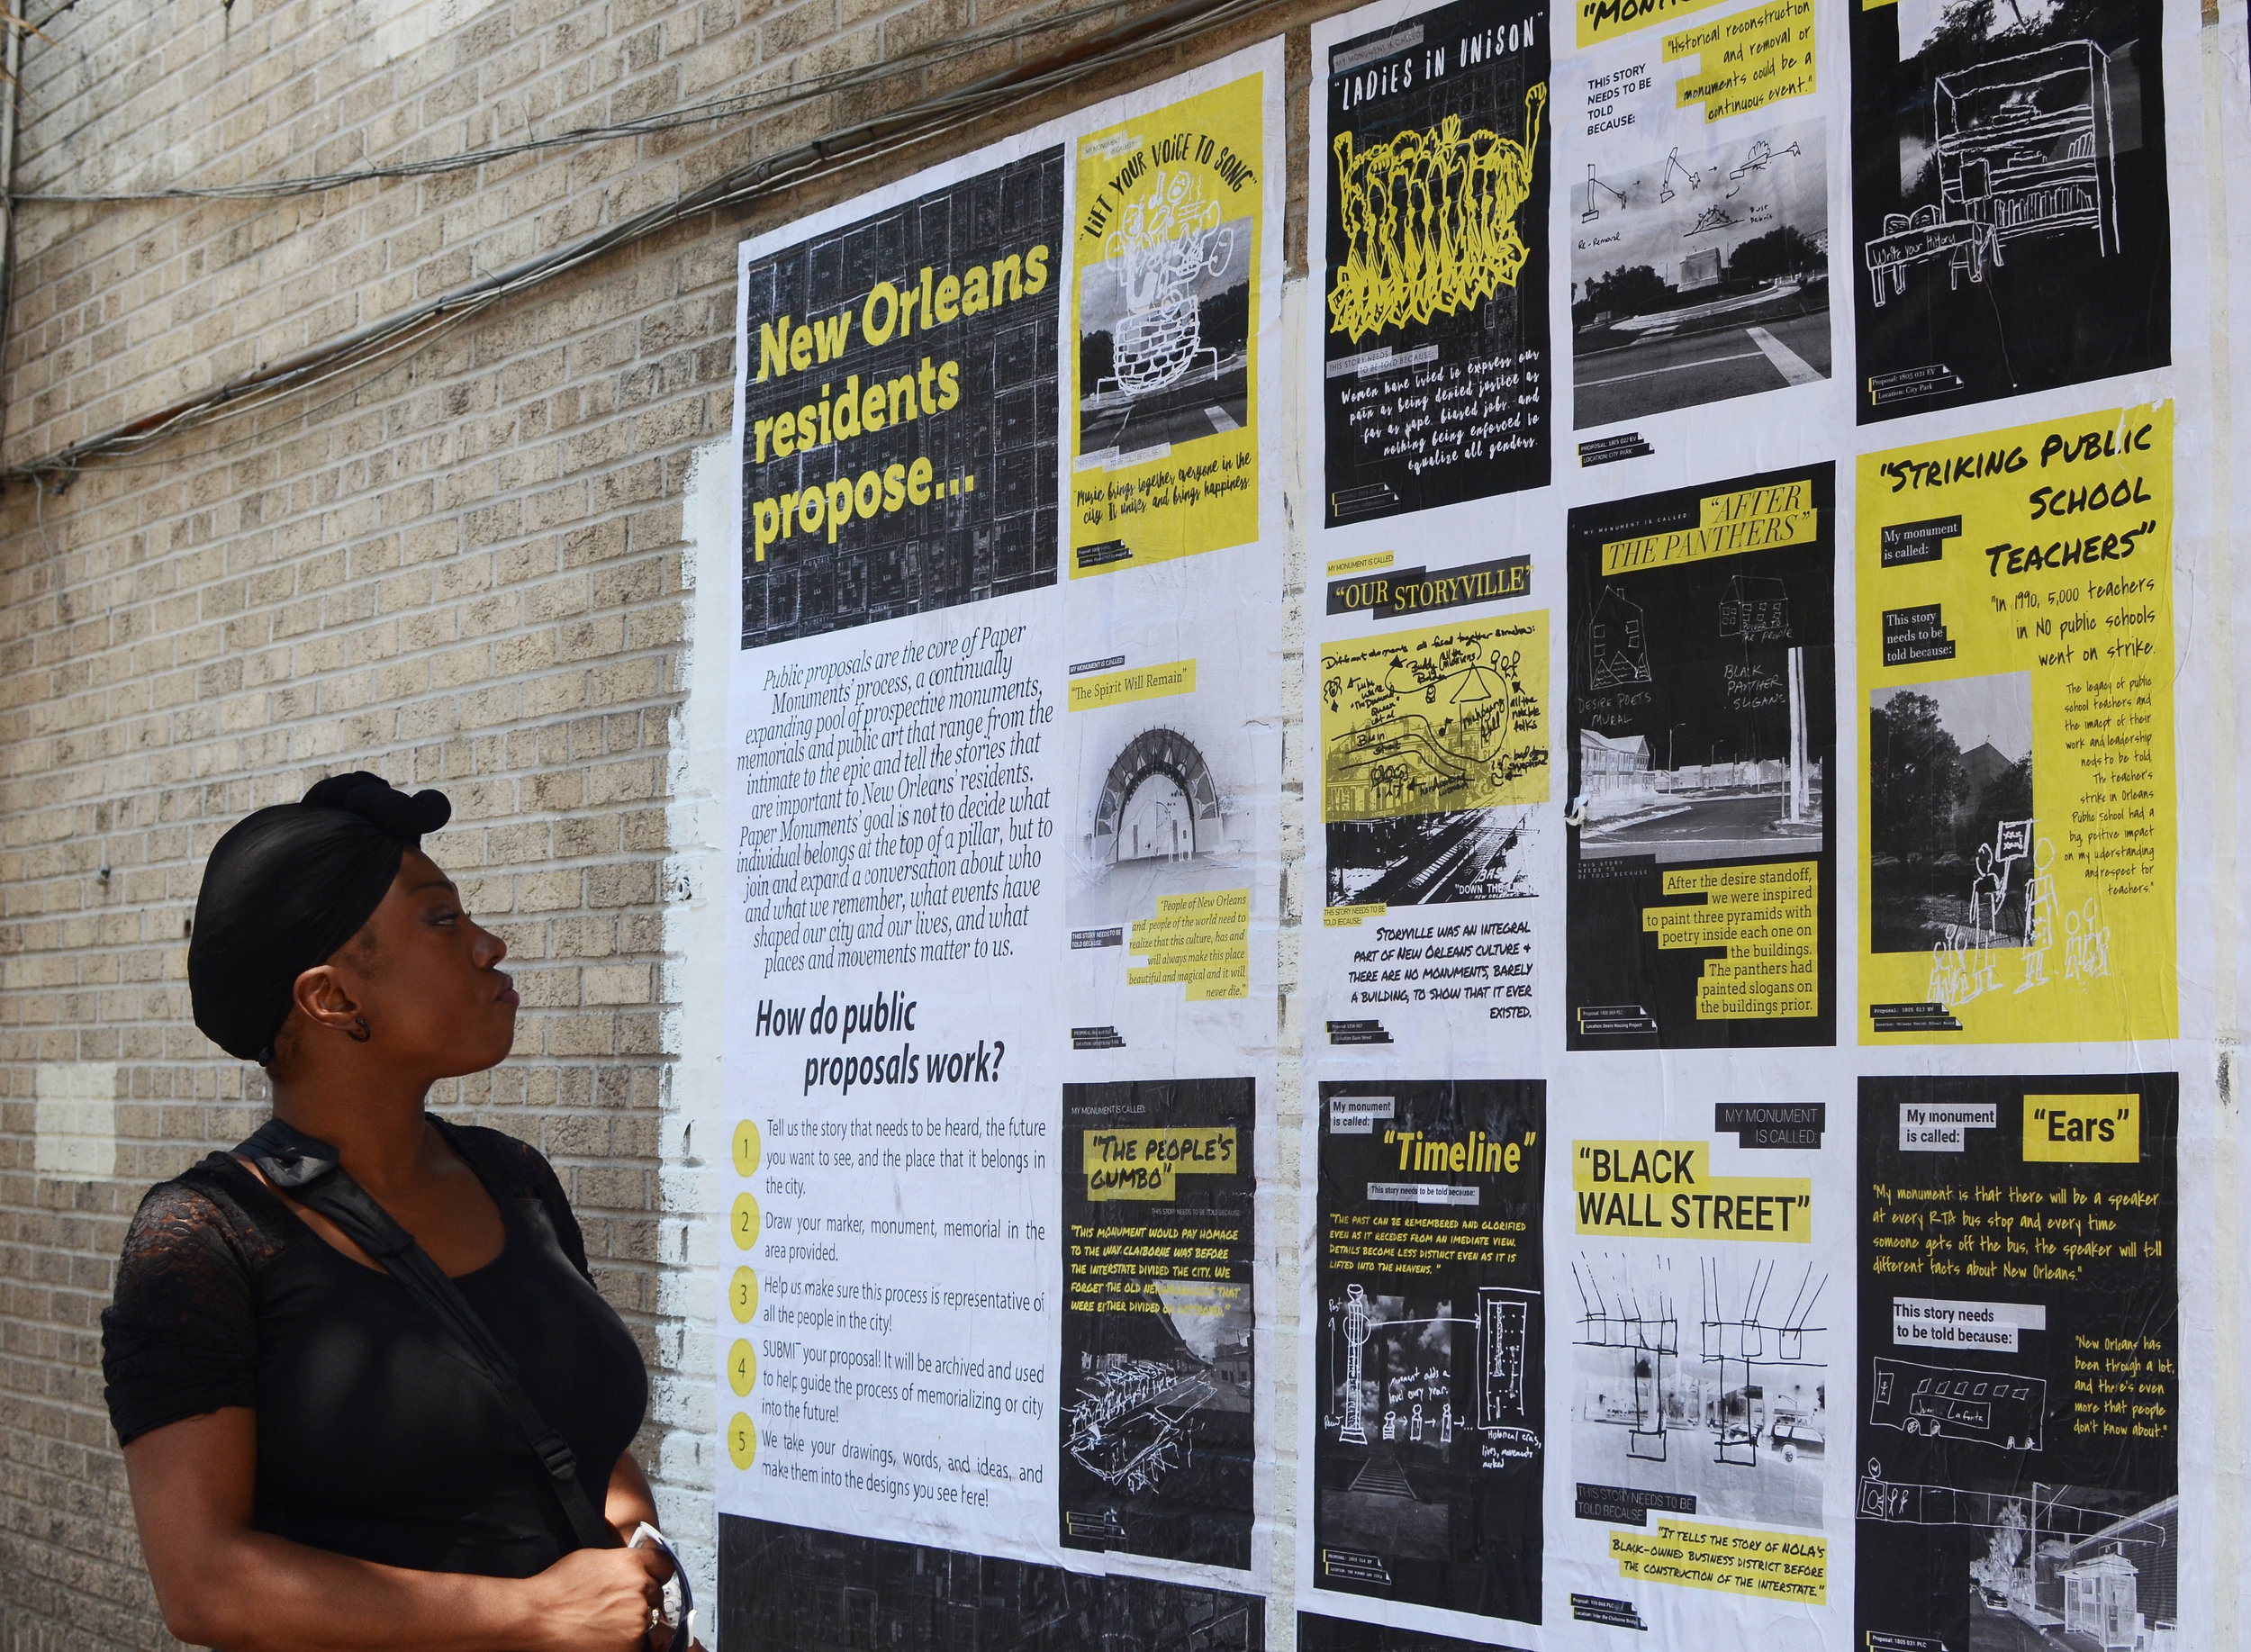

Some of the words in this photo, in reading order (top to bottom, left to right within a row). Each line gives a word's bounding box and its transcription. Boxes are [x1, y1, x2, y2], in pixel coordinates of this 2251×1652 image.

[1726, 0, 1810, 37] reconstruction
[1723, 43, 1743, 63] and
[1749, 28, 1790, 56] removal
[1799, 26, 1811, 41] or
[1588, 75, 1611, 90] THIS
[1613, 63, 1646, 81] STORY
[1587, 89, 1620, 105] NEEDS
[1623, 83, 1636, 95] TO
[1639, 77, 1651, 91] BE
[1588, 105, 1613, 121] TOLD
[1587, 114, 1635, 135] BECAUSE:
[1108, 151, 1147, 195] YOUR
[1195, 135, 1214, 164] TO
[1214, 147, 1257, 193] SONG"
[757, 310, 851, 384] New
[861, 244, 1049, 347] Orleans
[1341, 388, 1379, 404] Women
[1384, 378, 1410, 396] have
[1415, 371, 1444, 388] tried
[1451, 367, 1461, 380] to
[1468, 356, 1512, 375] express
[1519, 350, 1540, 363] our
[1878, 391, 1904, 399] Location:
[1920, 383, 1932, 392] Park
[755, 357, 960, 463] residents
[753, 455, 974, 561] propose...
[1711, 484, 1802, 523] "AFTER
[1609, 537, 1659, 570] THE
[1663, 511, 1810, 561] PANTHERS"
[1884, 530, 1901, 544] My
[1903, 522, 1957, 539] monument
[1336, 560, 1367, 570] MONUMENT
[1374, 555, 1394, 564] CALLED:
[1884, 549, 1893, 560] is
[1895, 544, 1929, 559] called:
[1336, 580, 1388, 608] "OUR
[1395, 565, 1534, 610] STORYVILLE"
[763, 661, 803, 691] Public
[804, 650, 871, 690] proposals
[875, 652, 899, 669] are
[902, 641, 925, 664] the
[927, 639, 959, 661] core
[962, 628, 980, 660] of
[981, 623, 1026, 652] Paper
[2039, 647, 2075, 666] went
[2083, 646, 2098, 661] on
[2108, 636, 2156, 656] strike.
[1071, 687, 1091, 700] "The
[1095, 681, 1121, 700] Spirit
[1125, 675, 1144, 691] Will
[1146, 668, 1187, 687] Remain"
[1667, 877, 1697, 889] After
[1700, 874, 1718, 887] the
[1721, 871, 1756, 886] desire
[1760, 868, 1812, 883] standoff,
[1713, 894, 1728, 904] we
[1731, 892, 1759, 903] were
[1762, 886, 1813, 903] inspired
[1437, 925, 1461, 937] WAS
[1463, 924, 1478, 935] AN
[1481, 921, 1531, 935] INTEGRAL
[764, 951, 804, 979] places
[808, 946, 834, 969] and
[837, 942, 916, 967] movements
[920, 937, 970, 960] matter
[974, 940, 988, 957] to
[992, 937, 1014, 957] us.
[1731, 946, 1749, 958] the
[1753, 943, 1812, 958] buildings.
[1709, 963, 1731, 976] The
[1734, 961, 1787, 980] panthers
[1791, 961, 1813, 973] had
[1207, 988, 1226, 998] never
[1228, 983, 1245, 996] die."
[755, 999, 806, 1036] How
[809, 995, 838, 1034] do
[843, 990, 917, 1044] public
[1490, 1007, 1532, 1019] EXISTED.
[804, 1043, 919, 1097] proposals
[927, 1040, 1005, 1082] work?
[1333, 1102, 1346, 1113] My
[1349, 1102, 1391, 1111] monument
[1726, 1109, 1742, 1123] MY
[1746, 1109, 1818, 1123] MONUMENT
[1907, 1109, 1925, 1125] My
[1929, 1110, 1994, 1124] monument
[767, 1119, 784, 1136] Tell
[788, 1124, 798, 1136] us
[801, 1119, 818, 1136] the
[821, 1122, 847, 1141] story
[851, 1118, 872, 1137] that
[876, 1118, 908, 1137] needs
[911, 1123, 923, 1136] to
[927, 1118, 941, 1137] be
[945, 1118, 982, 1139] heard,
[986, 1118, 1005, 1136] the
[1009, 1117, 1046, 1137] future
[1333, 1117, 1340, 1125] is
[1342, 1116, 1370, 1126] called:
[2034, 1108, 2129, 1142] "Ears"
[1756, 1130, 1767, 1142] IS
[1770, 1129, 1817, 1143] CALLED:
[1906, 1129, 1917, 1142] is
[1921, 1128, 1960, 1143] called:
[744, 1138, 748, 1159] 1
[1145, 1133, 1234, 1161] PEOPLE'S
[1384, 1130, 1536, 1173] "Timeline"
[1090, 1162, 1171, 1189] GUMBO"
[1579, 1147, 1695, 1185] "BLACK
[741, 1212, 748, 1232] 2
[1578, 1191, 1662, 1227] WALL
[1671, 1194, 1810, 1232] STREET"
[765, 1213, 791, 1229] Draw
[797, 1217, 820, 1234] your
[827, 1214, 864, 1235] marker,
[871, 1219, 937, 1238] monument,
[945, 1219, 1000, 1238] memorial
[1008, 1221, 1018, 1239] in
[1026, 1221, 1044, 1240] the
[1098, 1227, 1146, 1238] MONUMENT
[1149, 1228, 1178, 1238] WOULD
[1182, 1228, 1198, 1239] PAY
[1200, 1229, 1238, 1240] HOMAGE
[764, 1244, 786, 1258] area
[789, 1244, 838, 1263] provided.
[740, 1285, 747, 1304] 3
[738, 1358, 746, 1378] 4
[739, 1431, 746, 1451] 5
[1677, 1532, 1707, 1543] TELLS
[1711, 1535, 1728, 1547] THE
[1732, 1538, 1761, 1552] STORY
[1765, 1541, 1779, 1551] OF
